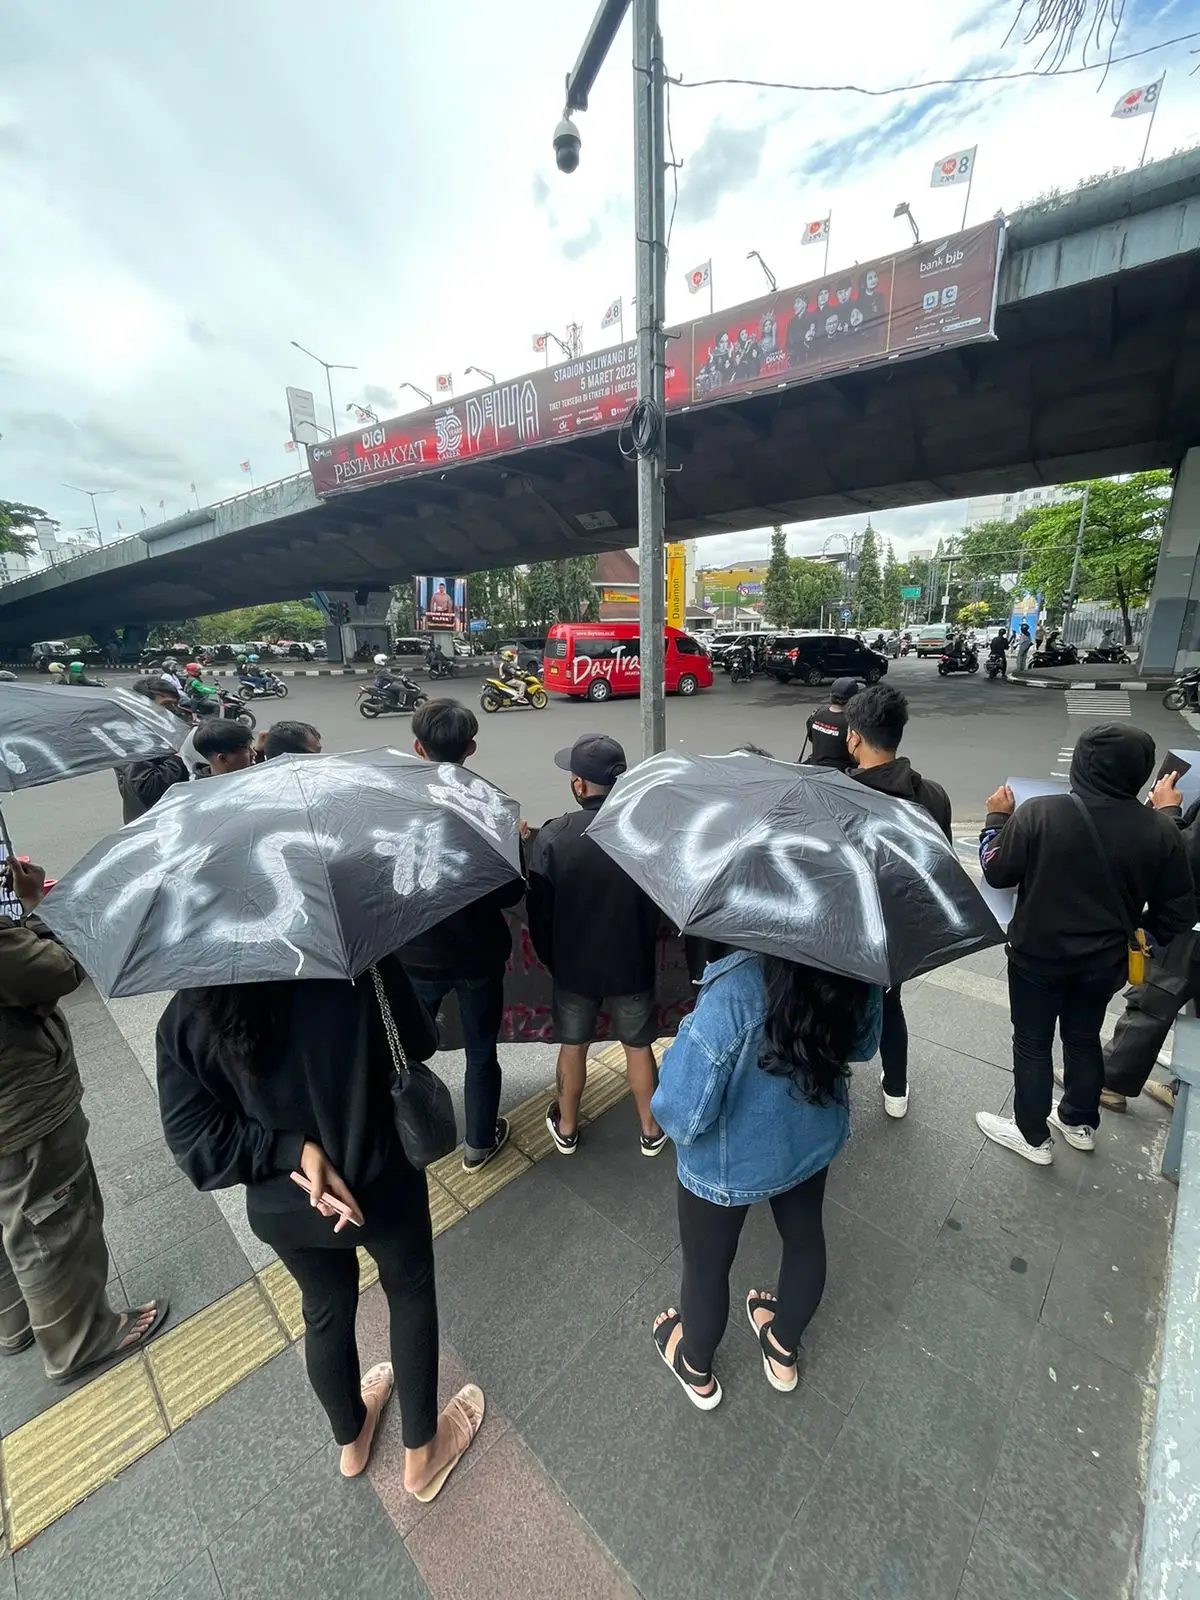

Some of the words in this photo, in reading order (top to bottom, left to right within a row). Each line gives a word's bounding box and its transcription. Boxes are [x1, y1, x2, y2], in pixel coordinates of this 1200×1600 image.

[920, 257, 943, 272] bank
[945, 250, 964, 264] bjb
[553, 363, 584, 382] STADION
[585, 350, 626, 372] SILIWANGI
[580, 377, 586, 390] 5
[587, 368, 614, 389] MARET
[615, 362, 636, 380] 2023
[362, 427, 386, 449] DIGI
[334, 456, 371, 484] PESTA
[372, 439, 427, 469] RAKYAT
[672, 578, 680, 620] Danamon
[572, 645, 640, 685] DayTra
